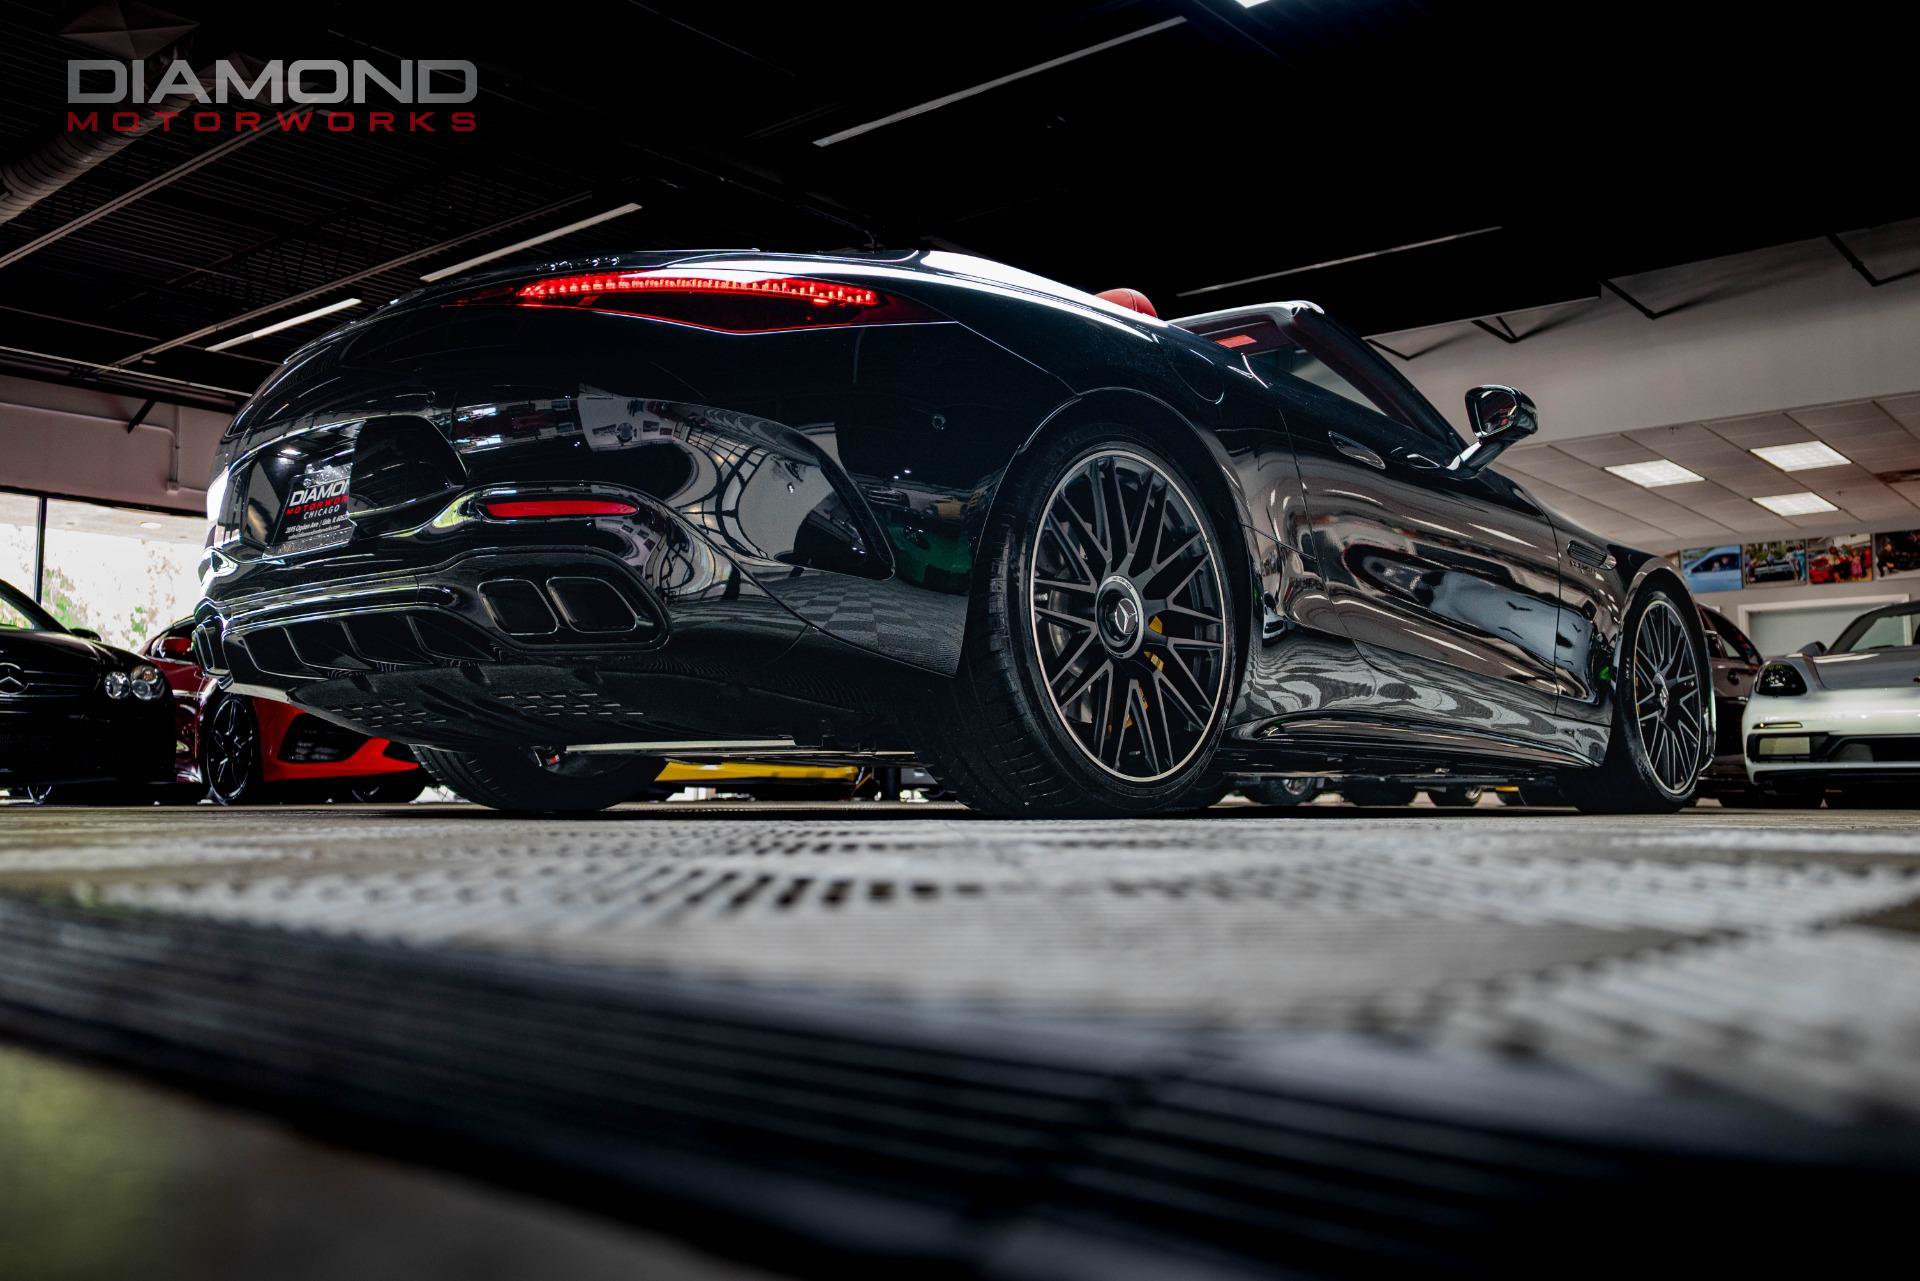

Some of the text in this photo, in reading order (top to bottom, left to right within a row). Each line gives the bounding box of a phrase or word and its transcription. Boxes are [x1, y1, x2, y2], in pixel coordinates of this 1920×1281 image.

[289, 479, 350, 506] DIAMON
[287, 495, 349, 515] MOTORWOR
[304, 504, 340, 519] CHICAGO
